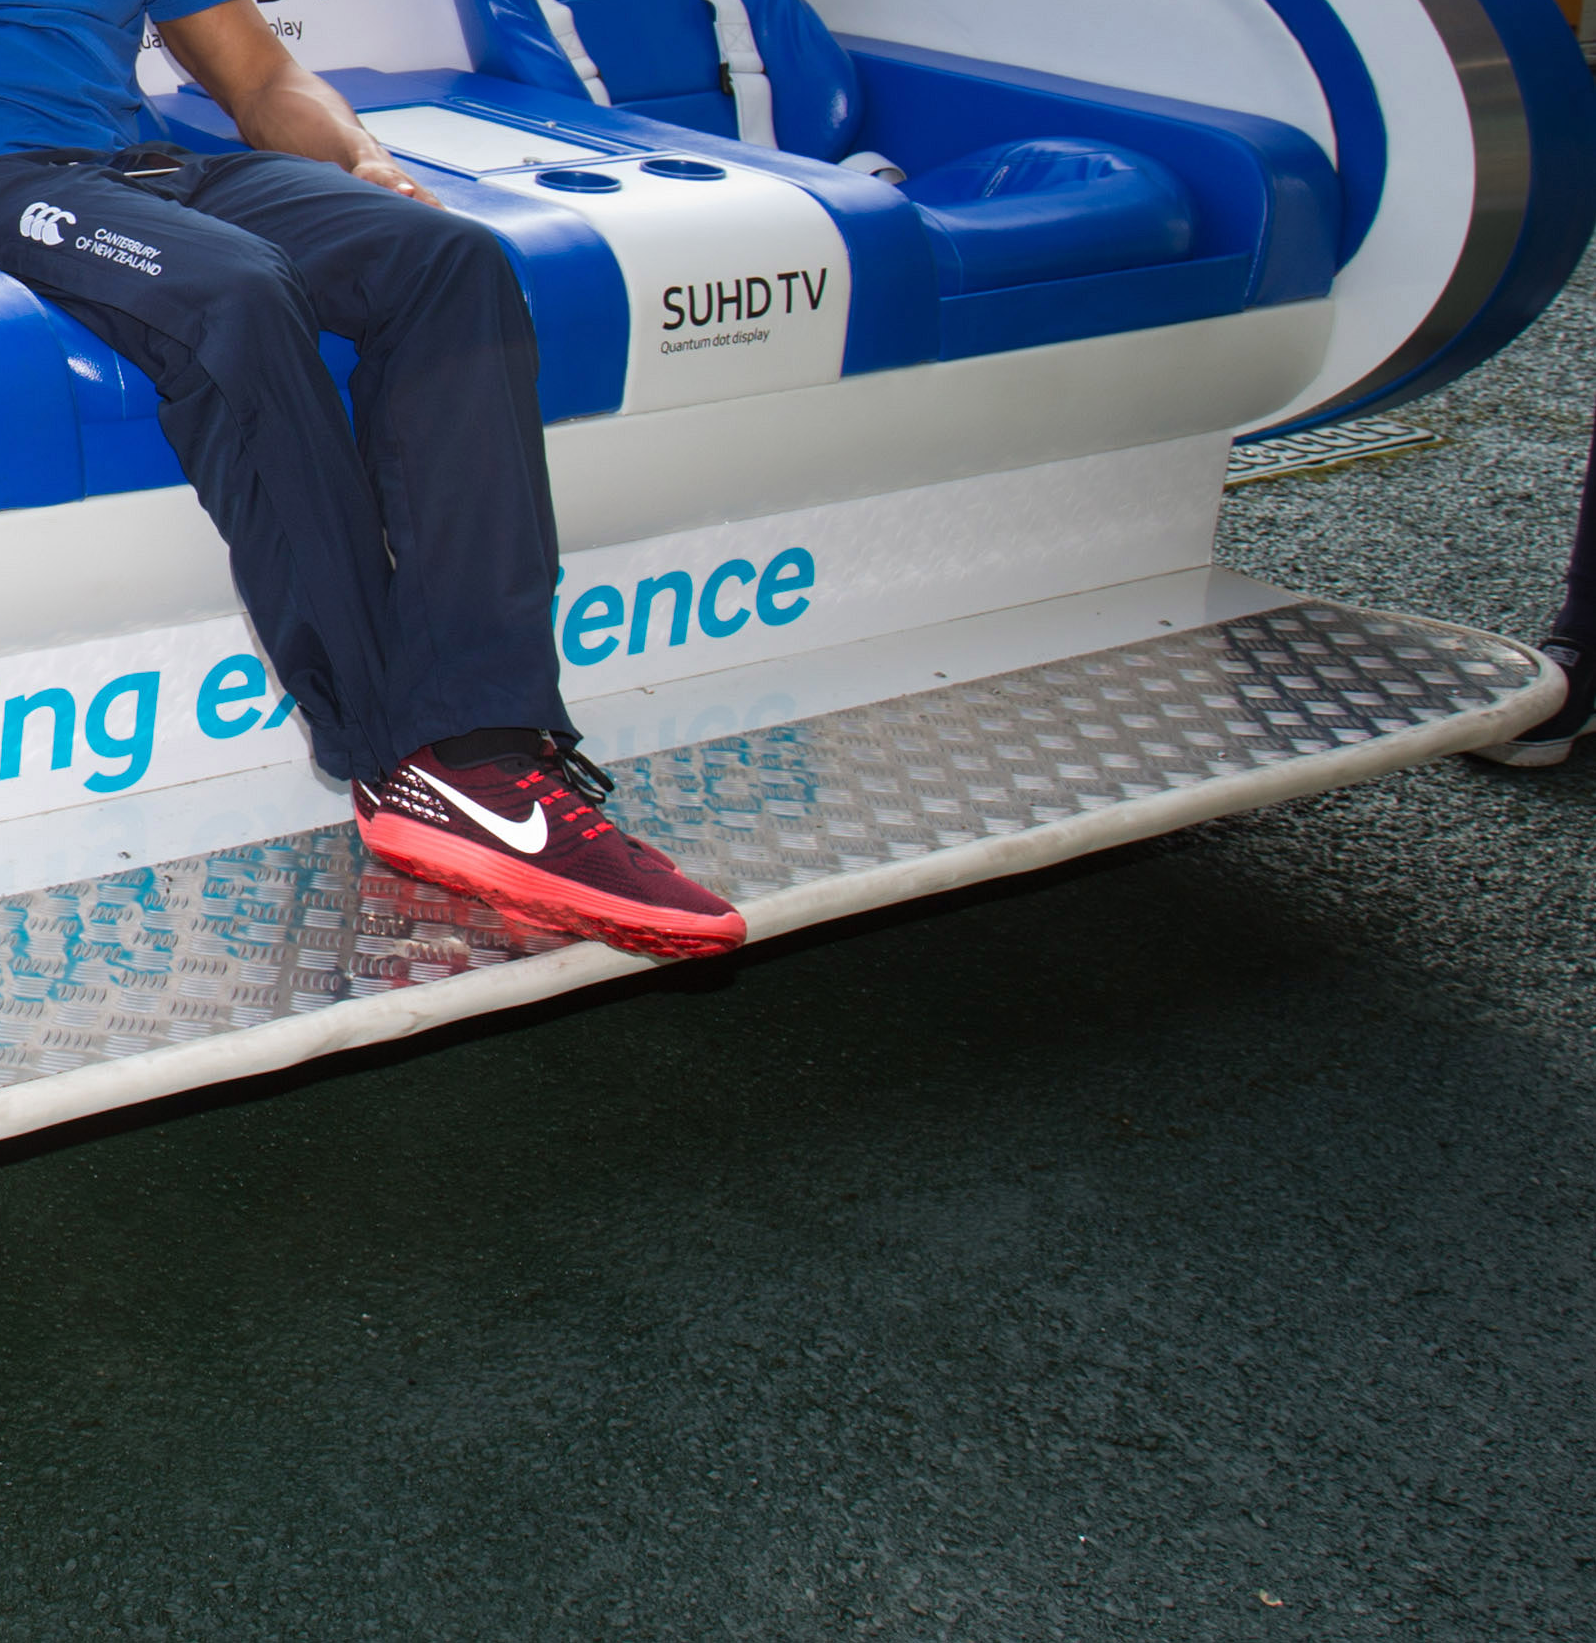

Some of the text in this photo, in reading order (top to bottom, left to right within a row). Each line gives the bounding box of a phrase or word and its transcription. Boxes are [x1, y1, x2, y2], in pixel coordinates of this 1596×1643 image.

[75, 236, 162, 276] OF NEW ZEALAND
[94, 228, 162, 260] CANTERBURY
[662, 267, 828, 331] SUHD TV
[660, 327, 771, 355] Quantum dot display
